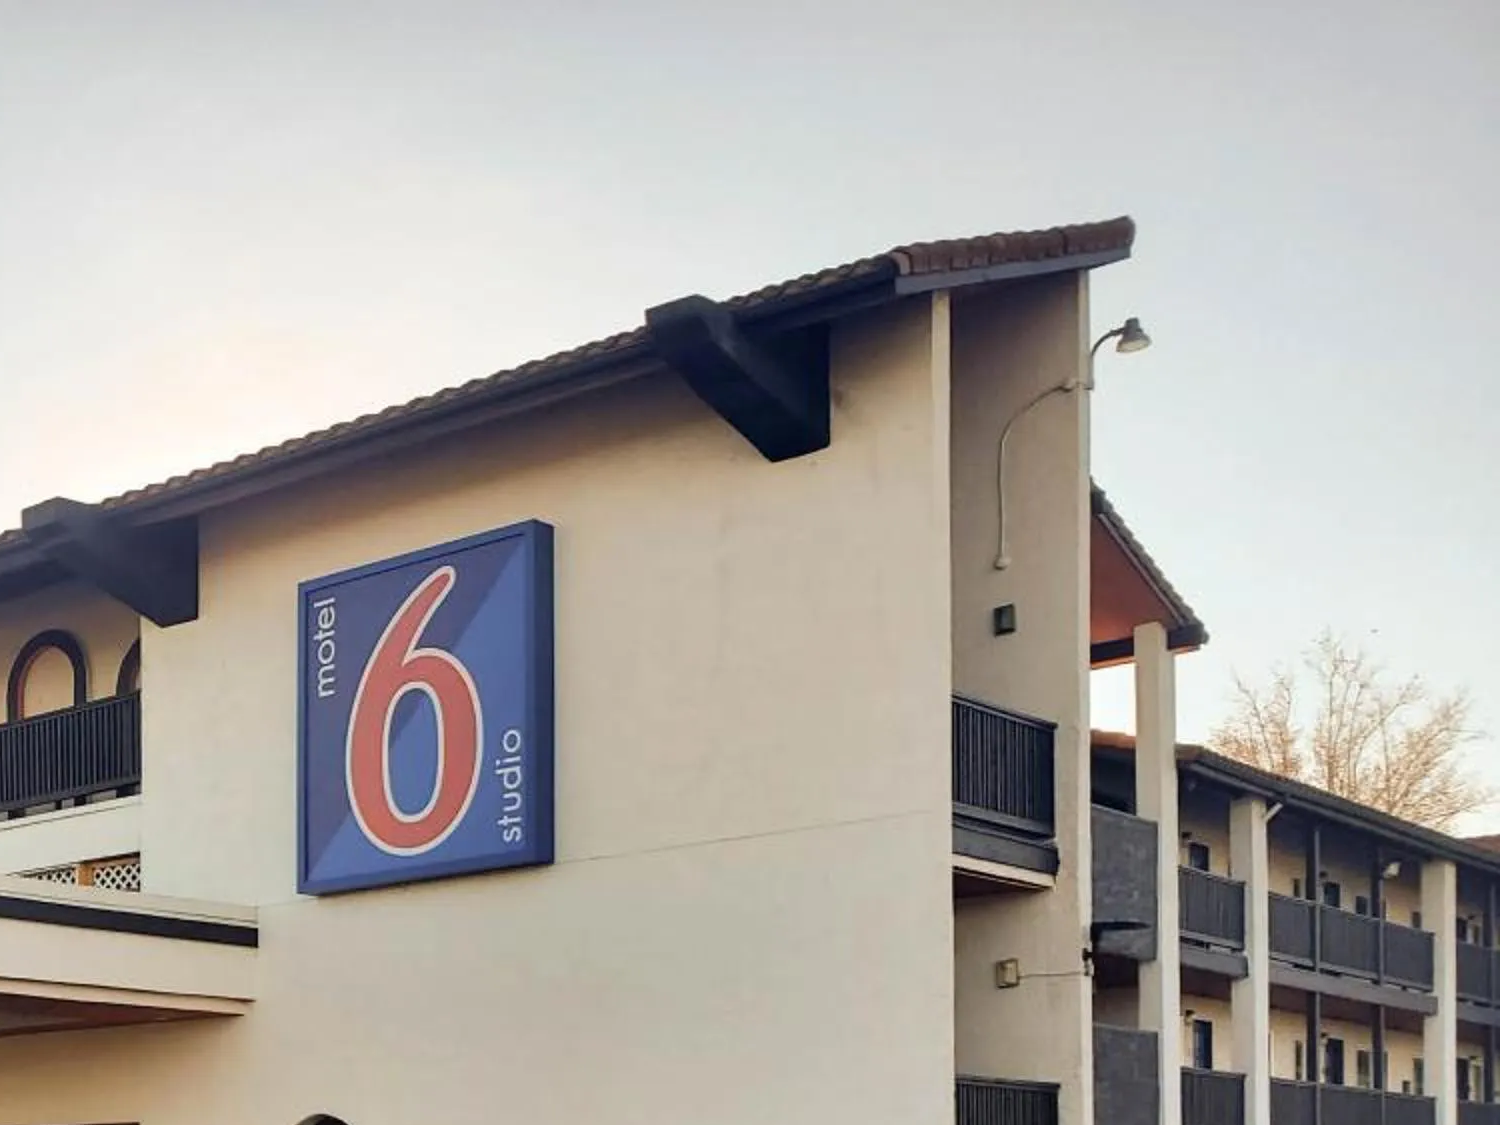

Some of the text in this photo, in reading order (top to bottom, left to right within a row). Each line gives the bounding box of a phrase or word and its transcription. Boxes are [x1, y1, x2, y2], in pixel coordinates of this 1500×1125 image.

[313, 596, 336, 698] motel
[345, 565, 484, 856] 6
[495, 729, 522, 842] studio
